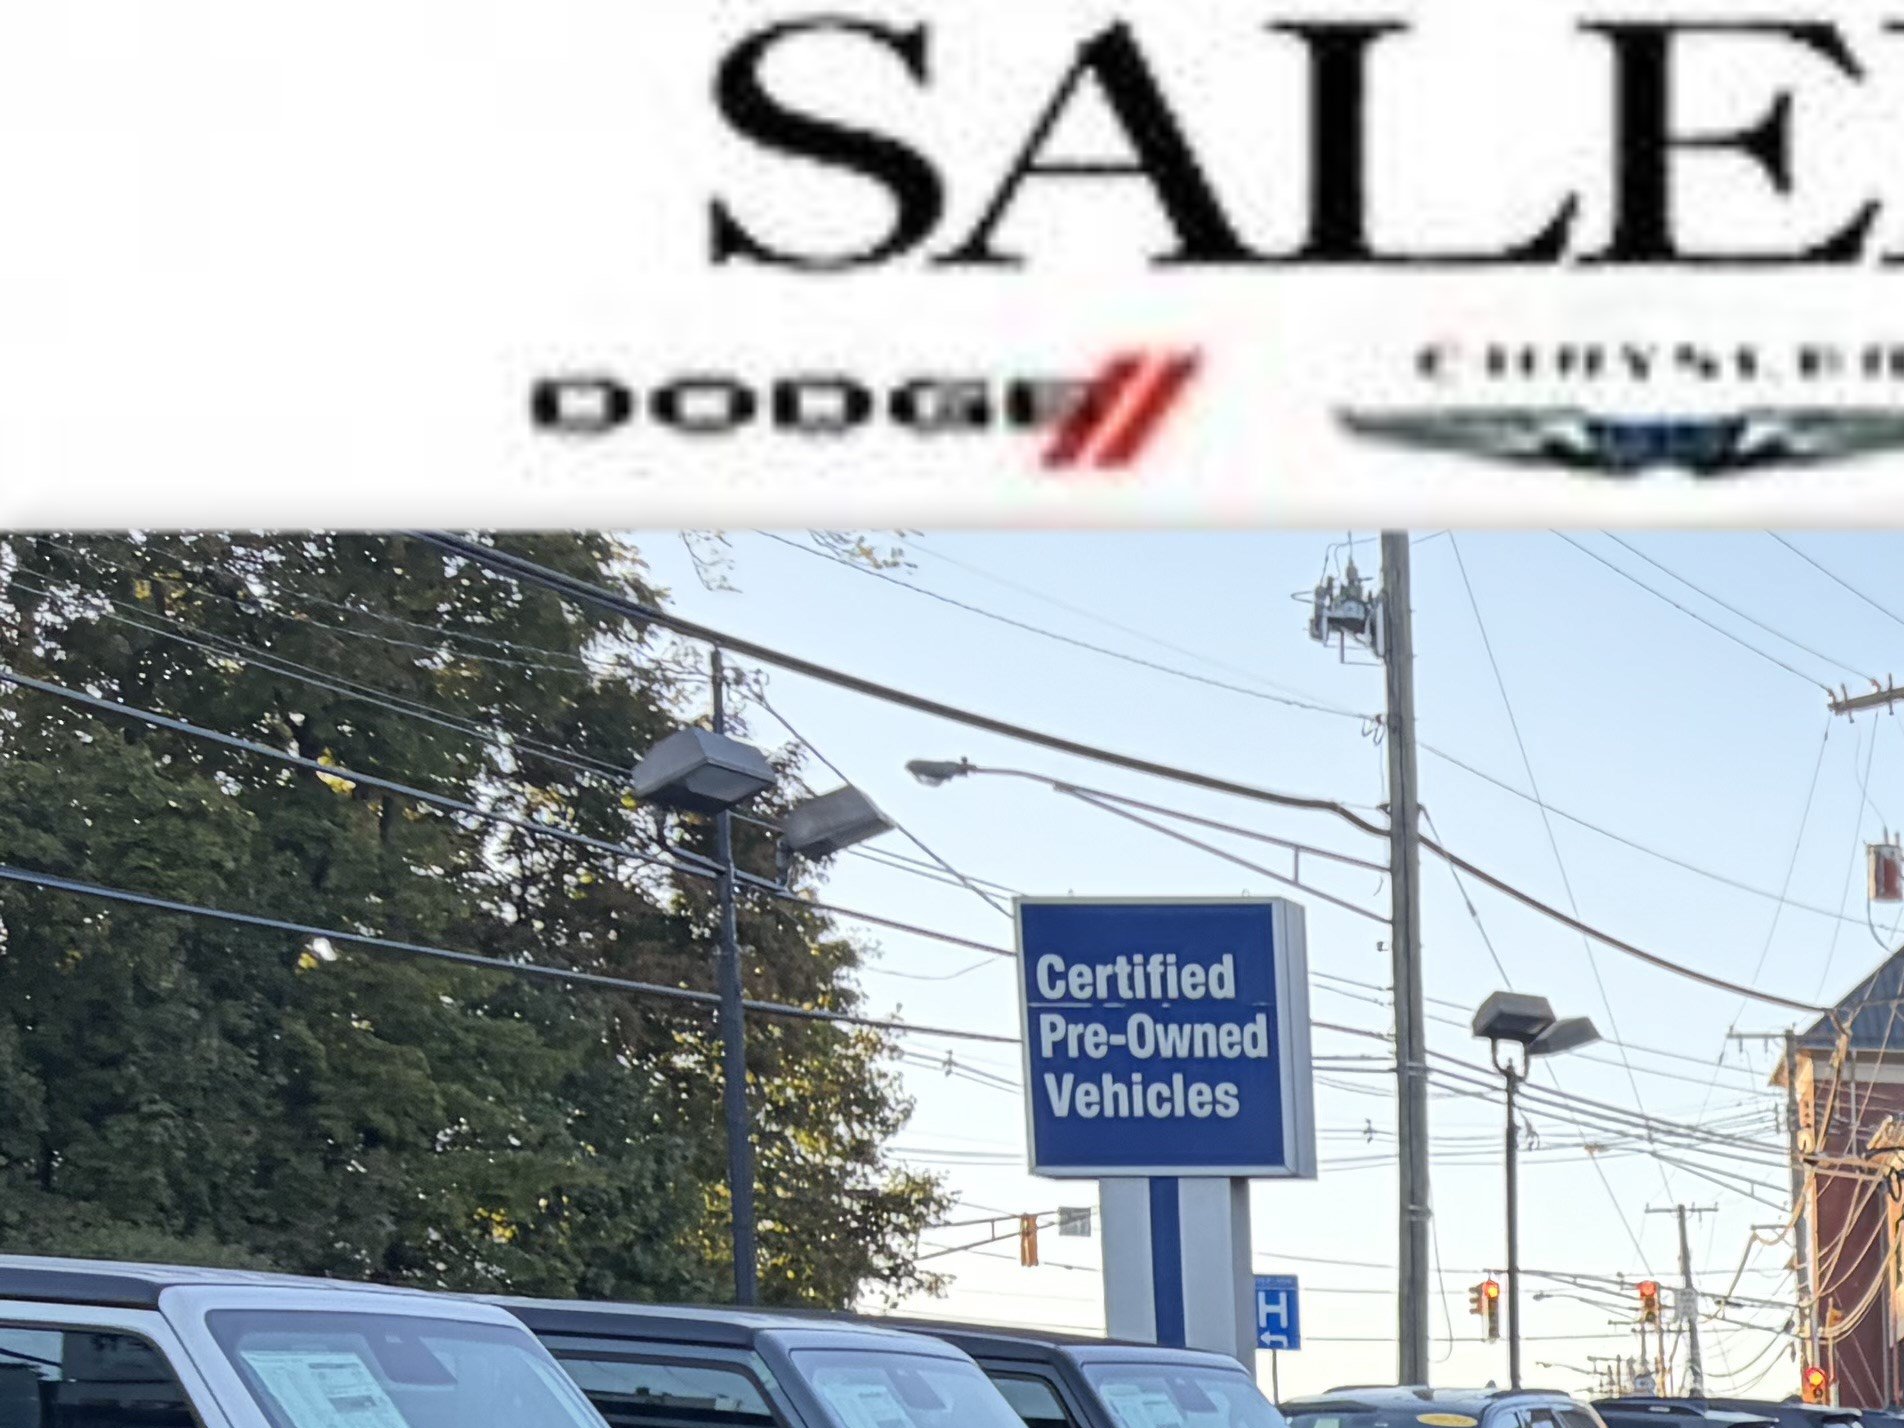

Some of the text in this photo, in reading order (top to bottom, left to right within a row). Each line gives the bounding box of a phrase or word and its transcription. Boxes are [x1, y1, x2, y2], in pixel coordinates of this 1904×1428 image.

[1036, 953, 1236, 1000] Certified
[1039, 1013, 1269, 1059] Pre-Owned
[1043, 1072, 1240, 1118] Vehicles
[1258, 1291, 1288, 1328] H
